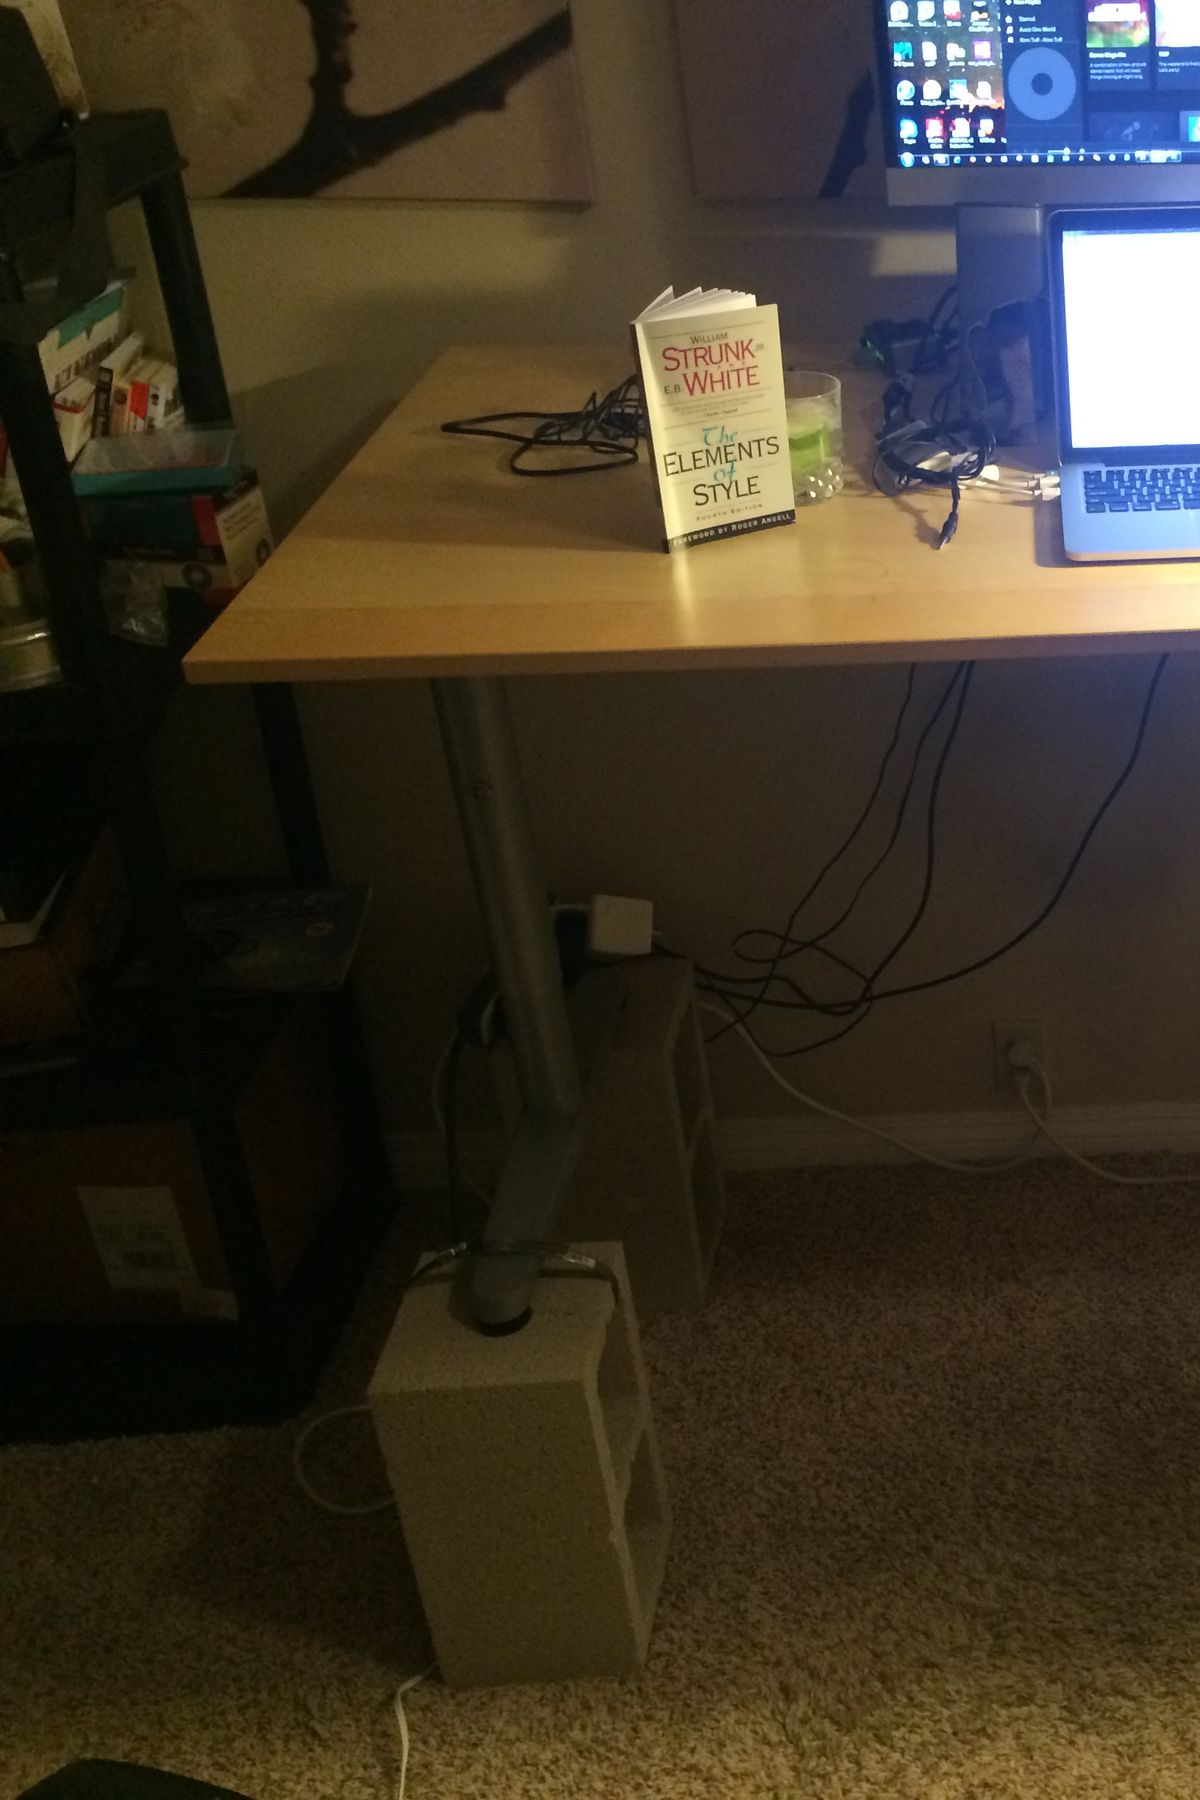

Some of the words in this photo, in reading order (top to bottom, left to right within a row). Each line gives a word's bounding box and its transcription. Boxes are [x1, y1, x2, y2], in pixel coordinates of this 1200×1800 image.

[690, 332, 728, 345] WILLIAM
[662, 338, 755, 372] STRUNK
[682, 365, 760, 396] WHITE
[702, 425, 738, 446] The
[663, 436, 779, 477] ELEMENTS
[713, 460, 736, 482] of
[693, 475, 761, 506] STYLE
[673, 530, 715, 545] FOREWORD
[718, 527, 728, 535] BY
[731, 520, 758, 532] ROGER
[761, 513, 791, 525] ANGELL
